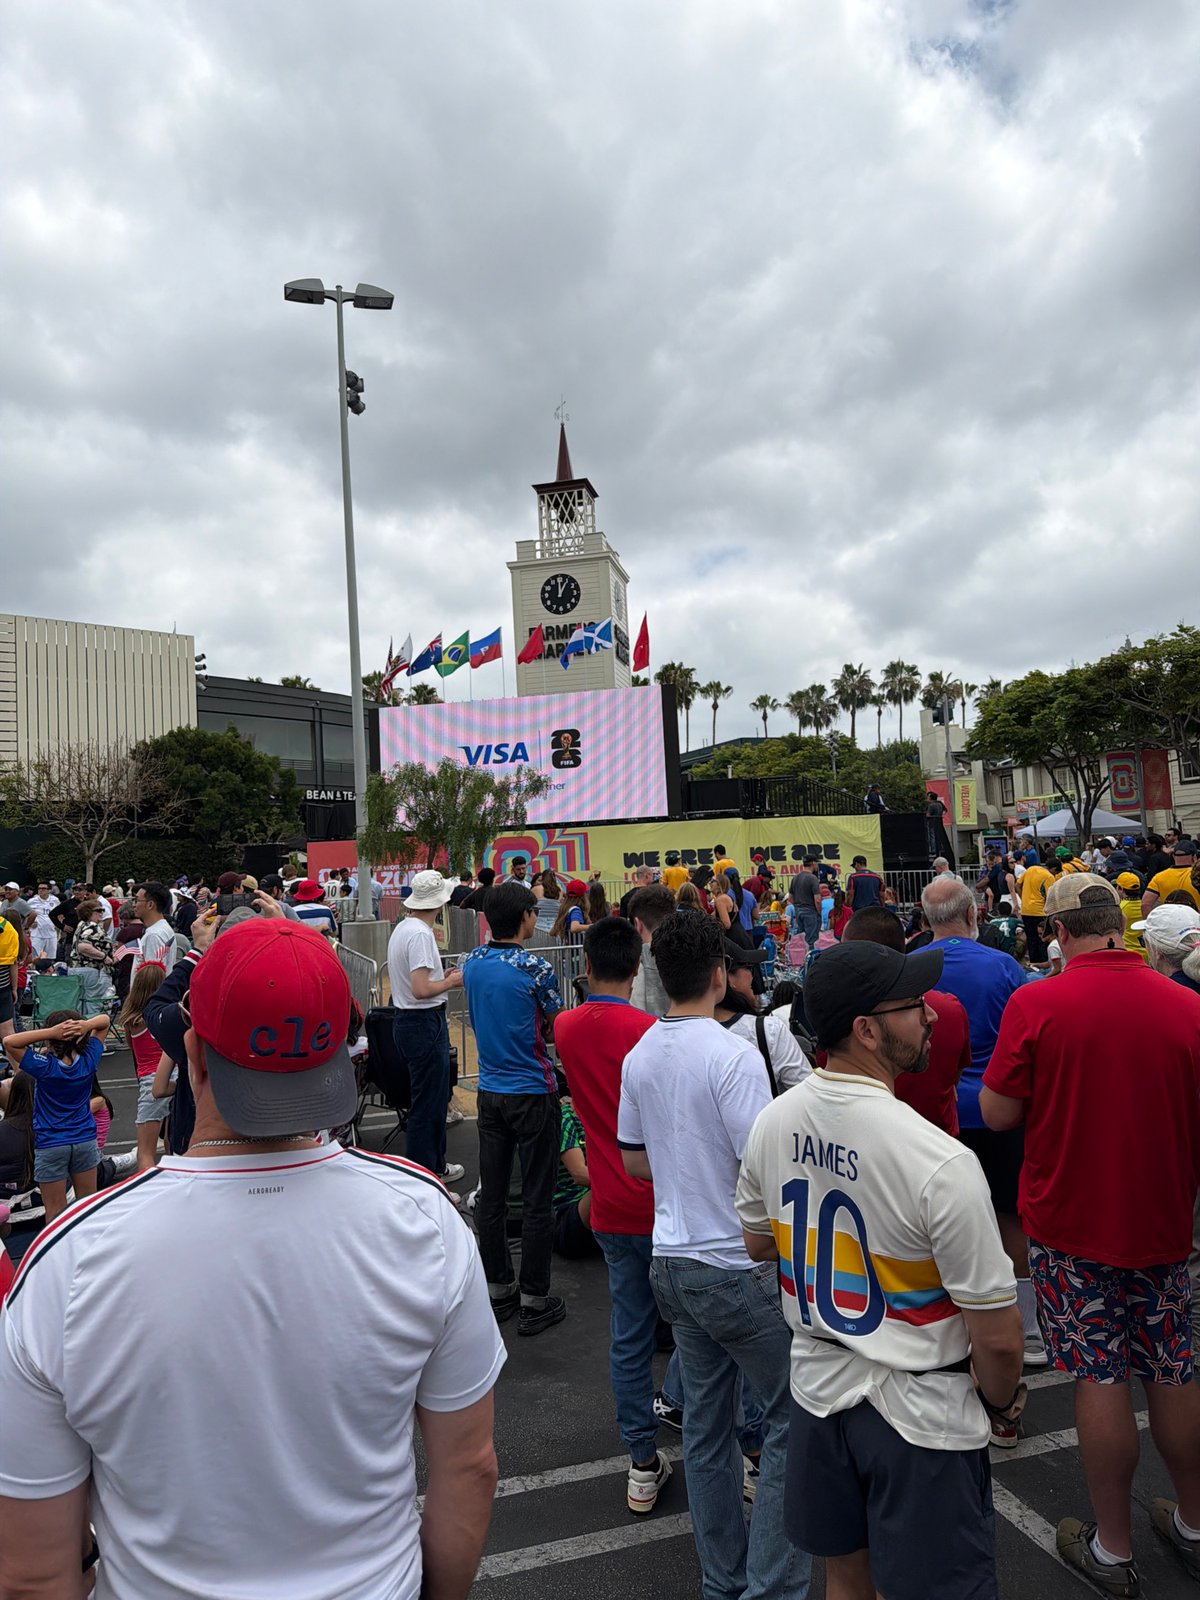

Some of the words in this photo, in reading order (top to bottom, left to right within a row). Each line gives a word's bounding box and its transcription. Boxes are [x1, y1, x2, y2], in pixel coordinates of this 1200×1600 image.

[458, 742, 530, 765] VISA
[306, 790, 334, 800] BEAN
[961, 784, 970, 818] WELCOME
[623, 851, 660, 868] WE
[327, 886, 337, 898] 10
[999, 921, 1010, 937] 4
[792, 1133, 858, 1181] JAMES
[248, 1186, 284, 1195] AEROREADY
[781, 1178, 887, 1336] 10
